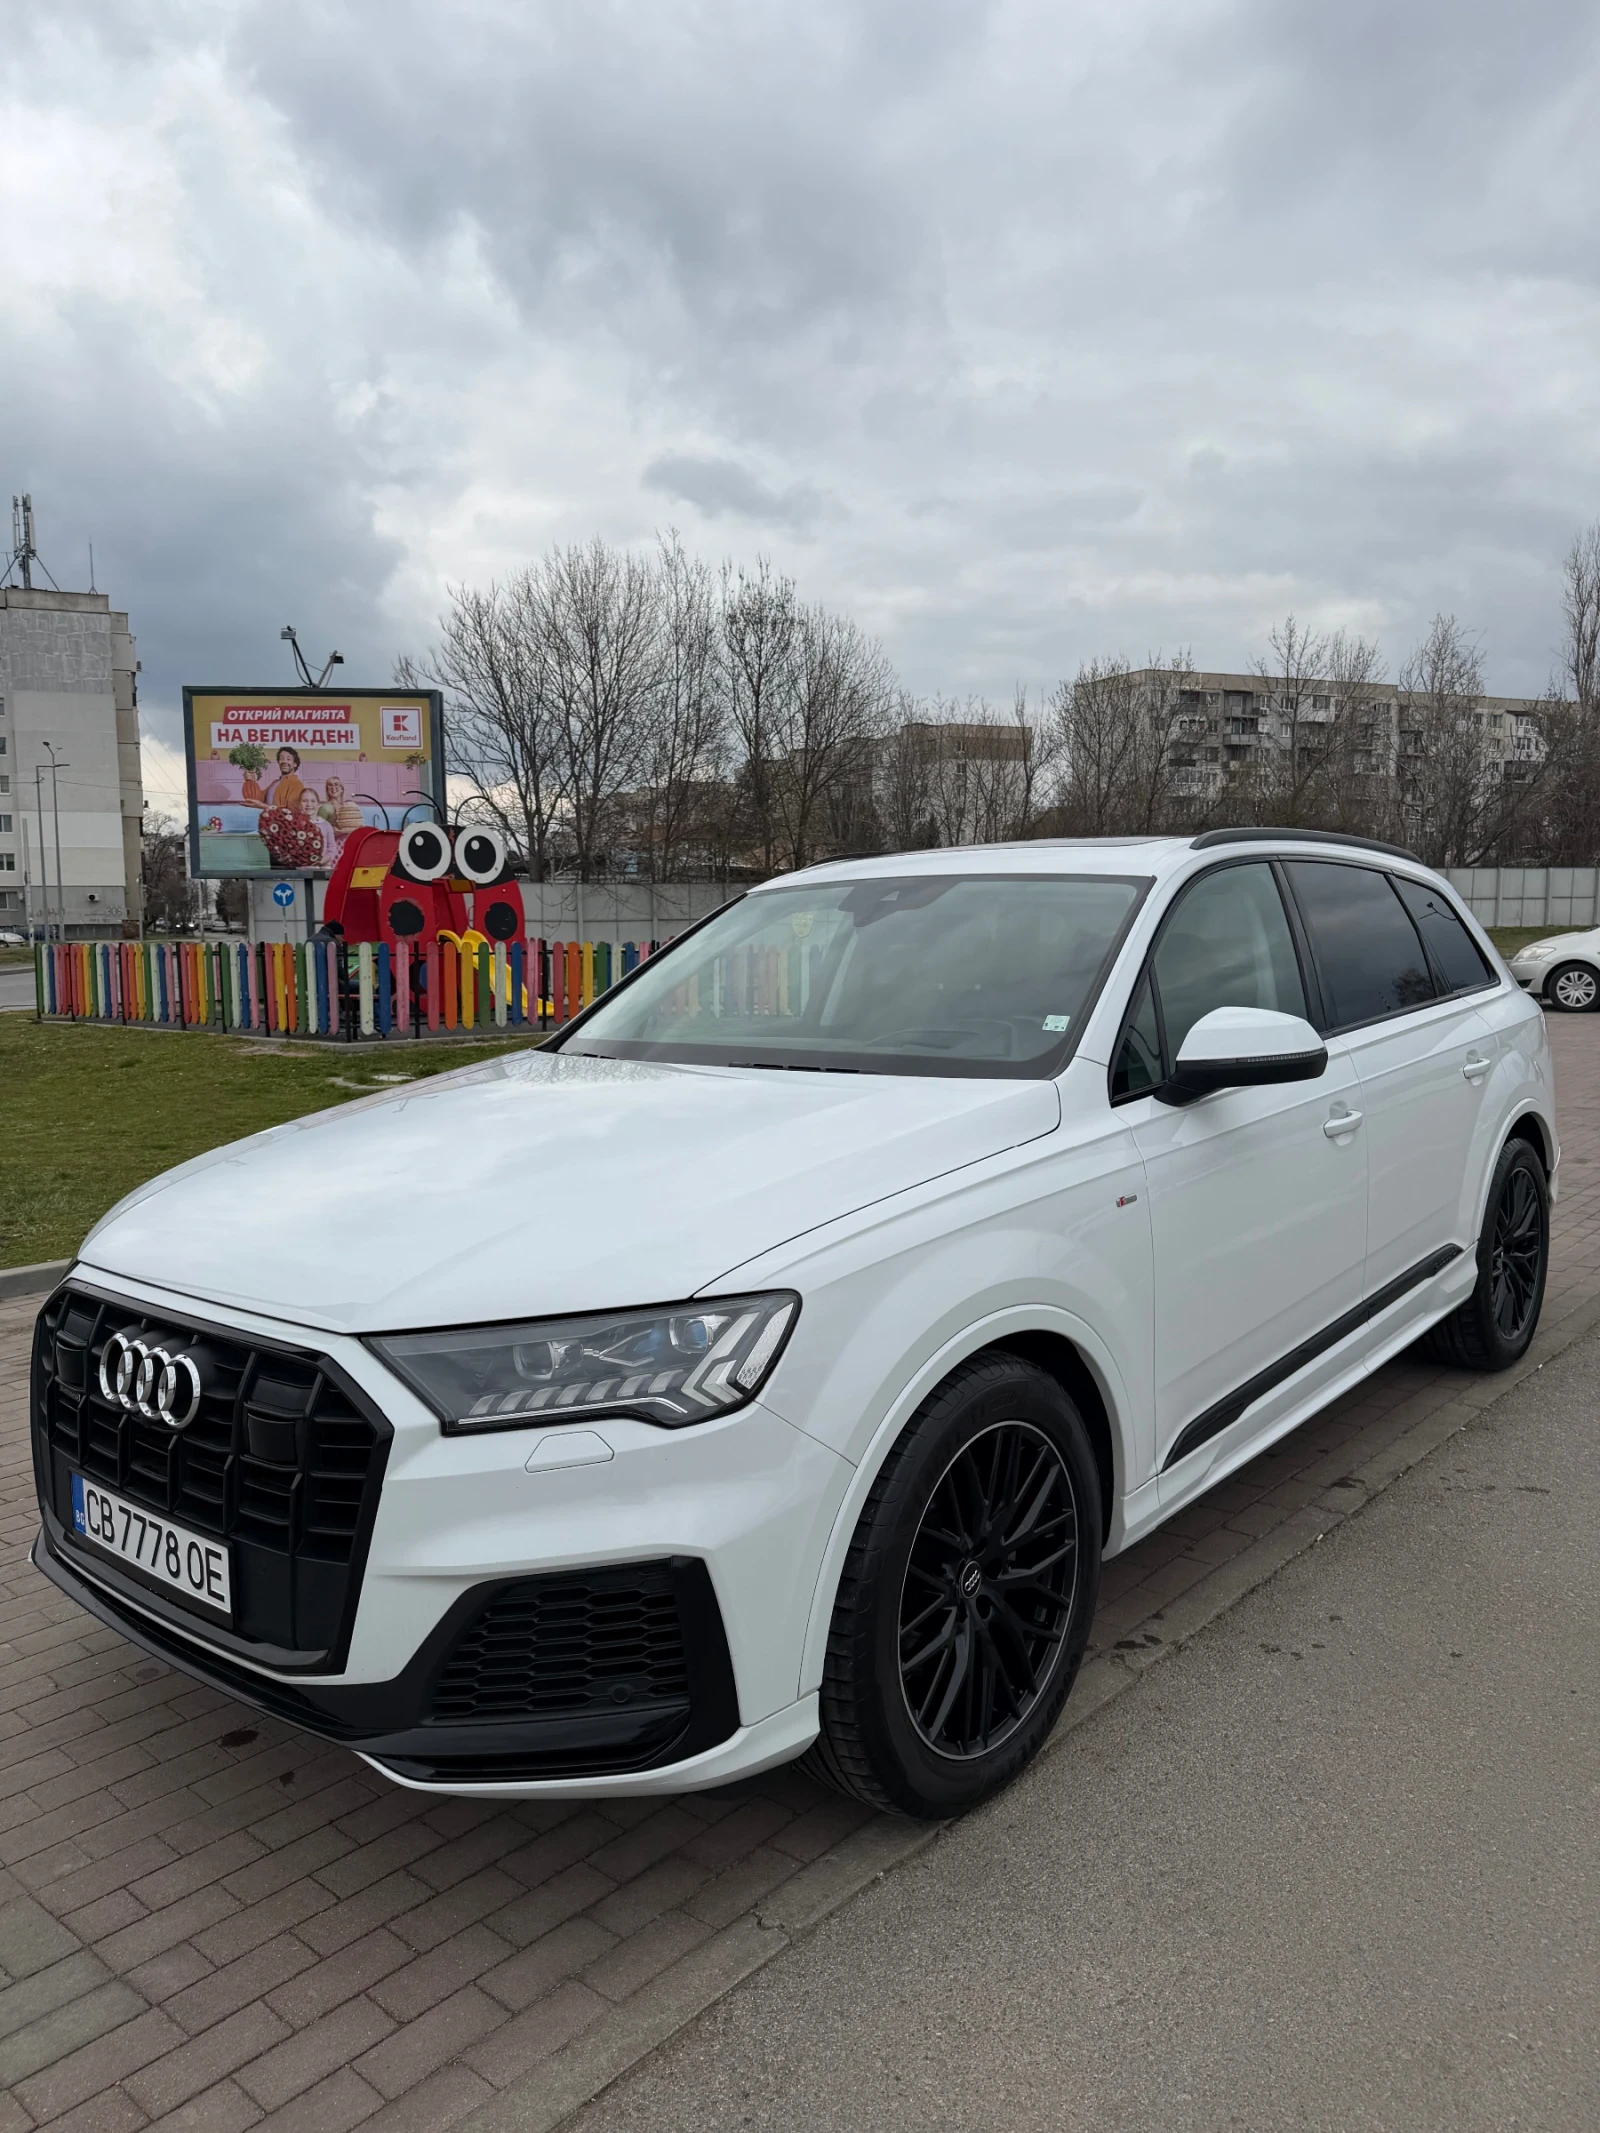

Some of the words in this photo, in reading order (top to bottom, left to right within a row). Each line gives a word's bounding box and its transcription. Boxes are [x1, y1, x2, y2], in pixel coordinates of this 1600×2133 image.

[227, 707, 281, 720] ОТКРИЙ
[283, 709, 346, 720] МАГИЯТА
[217, 728, 243, 742] НА
[75, 1509, 85, 1526] BG
